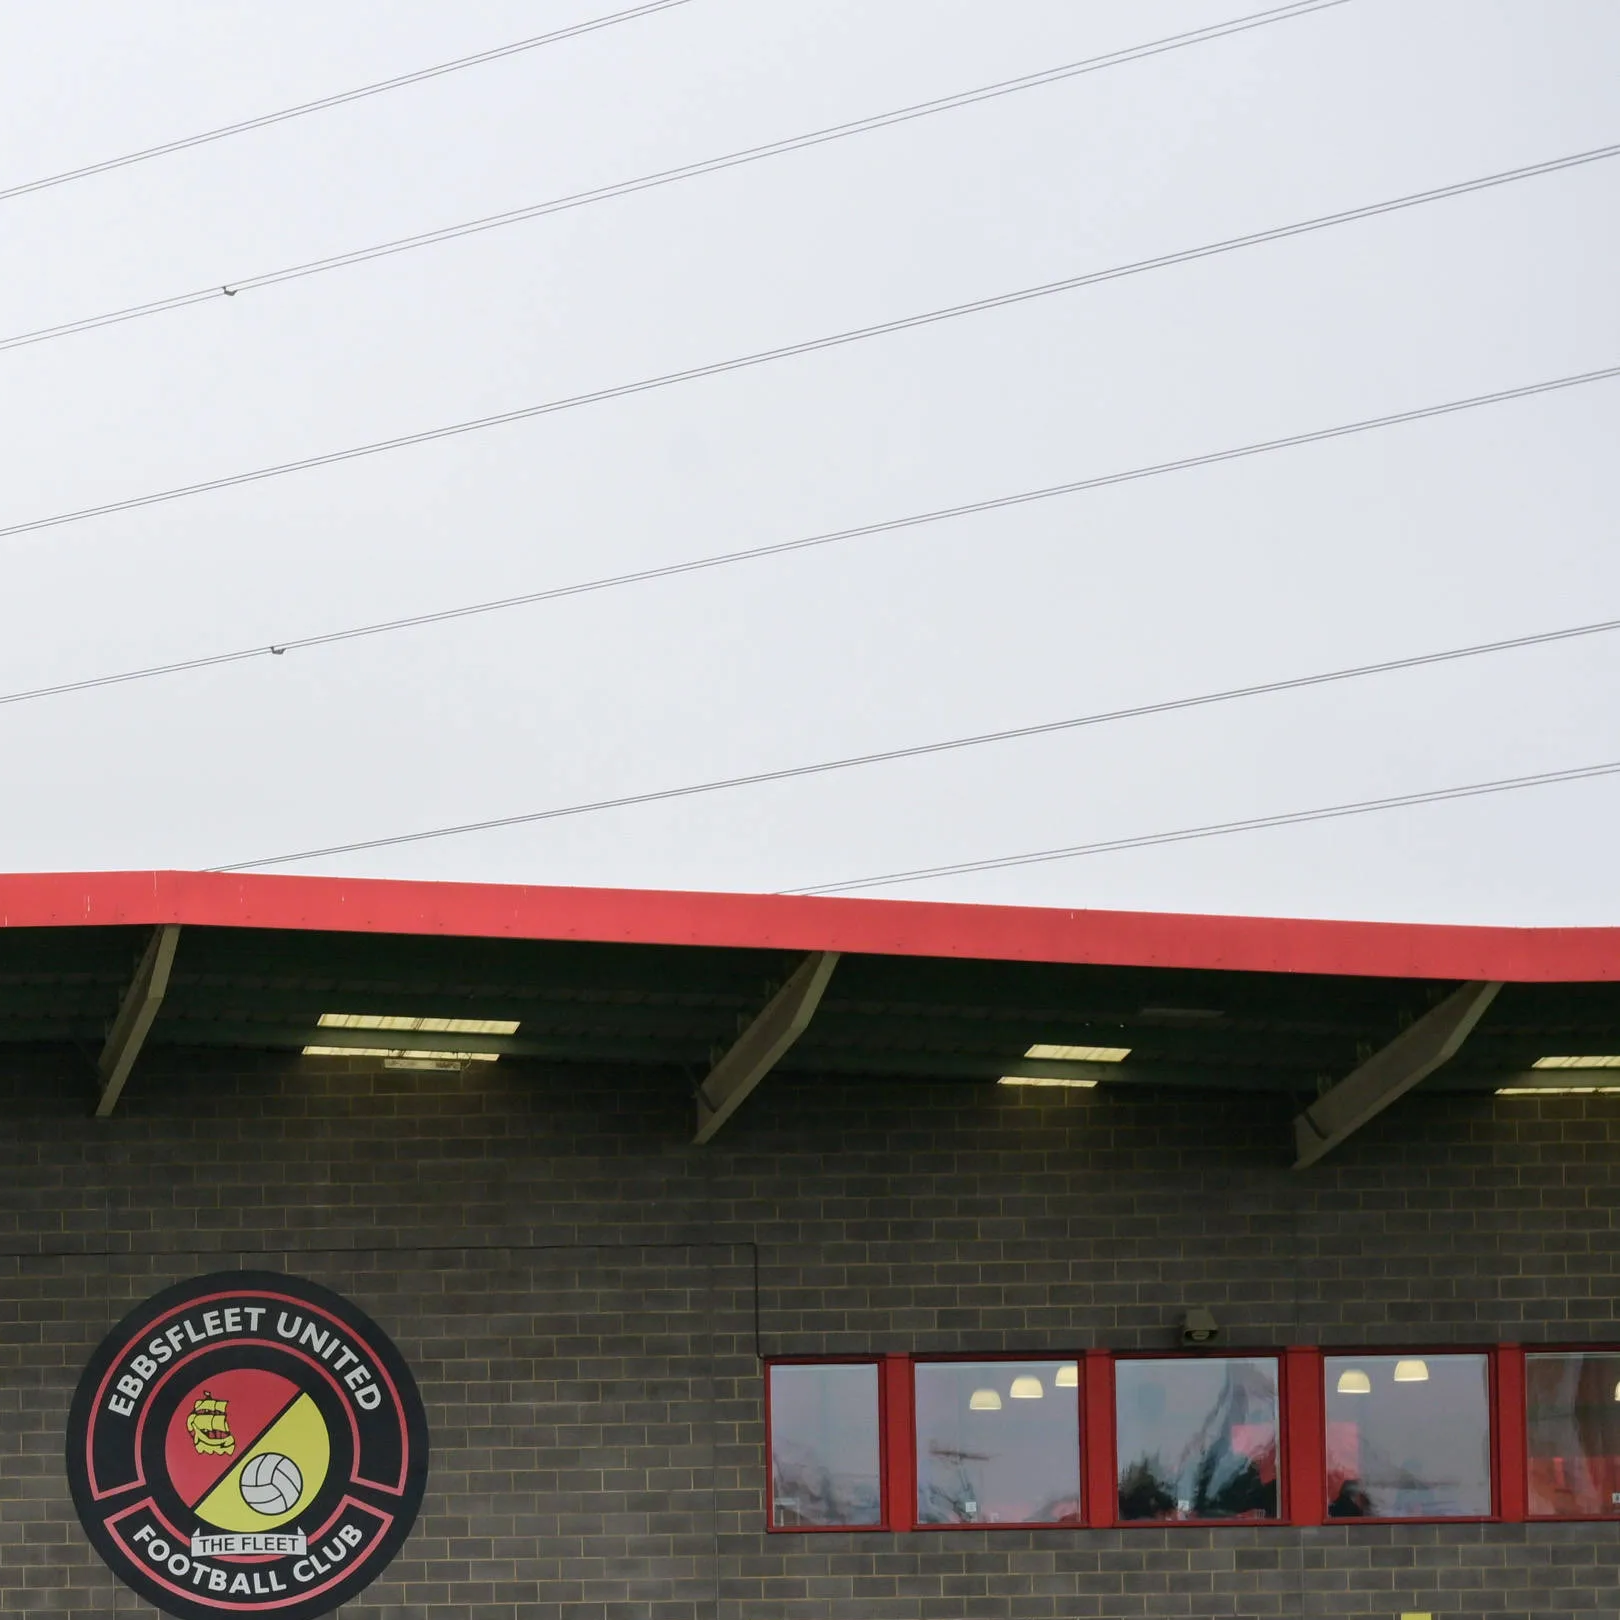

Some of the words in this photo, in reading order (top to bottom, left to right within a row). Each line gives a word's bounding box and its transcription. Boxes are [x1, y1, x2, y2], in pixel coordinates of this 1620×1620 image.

[107, 1306, 266, 1417] EBBSFLEET
[276, 1311, 382, 1411] UNITED
[132, 1524, 287, 1595] FOOTBALL
[292, 1523, 363, 1583] CLUB
[199, 1537, 237, 1553] THE
[241, 1536, 300, 1553] FLEET
